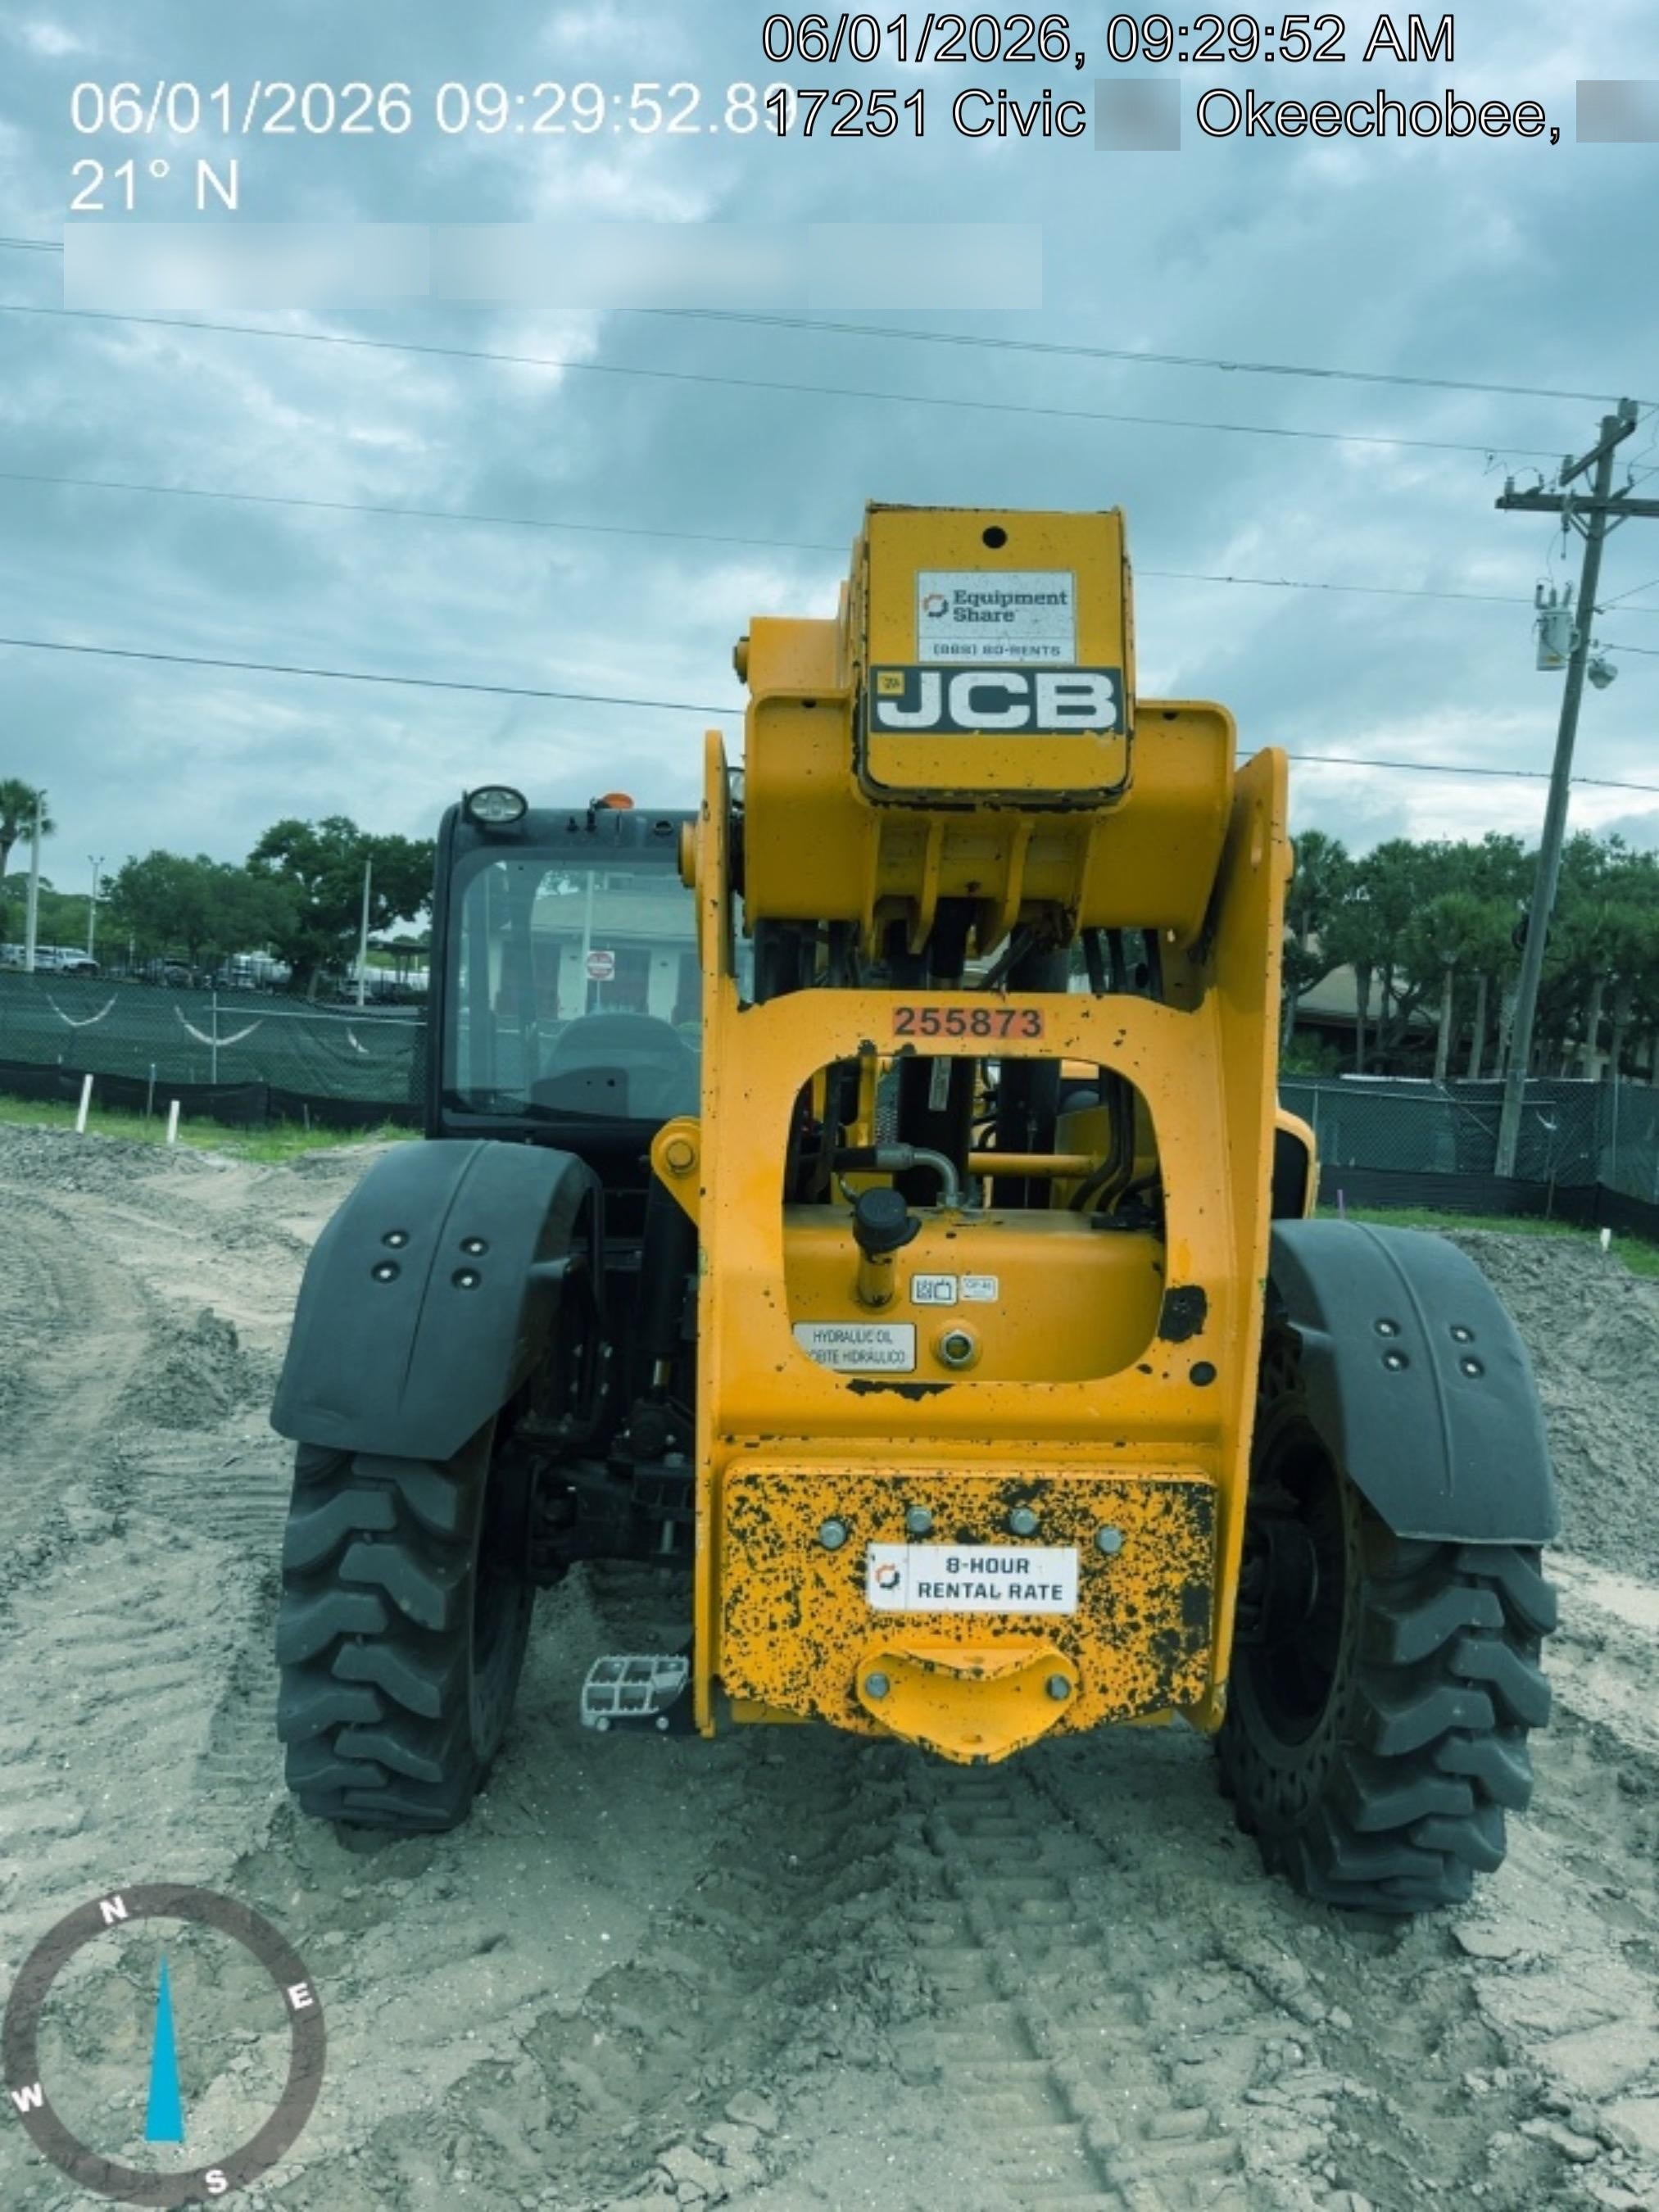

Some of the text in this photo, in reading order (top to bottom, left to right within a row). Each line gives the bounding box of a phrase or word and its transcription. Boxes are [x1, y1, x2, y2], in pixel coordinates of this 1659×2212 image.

[953, 590, 1067, 608] Equipment
[953, 607, 1015, 623] Share
[877, 671, 1117, 728] JCB
[895, 1009, 1041, 1037] 255873
[814, 1330, 893, 1344] HYDRAULIC OIL
[946, 1557, 1030, 1574] 8-HOUR
[918, 1583, 1063, 1601] RENTAL RATE
